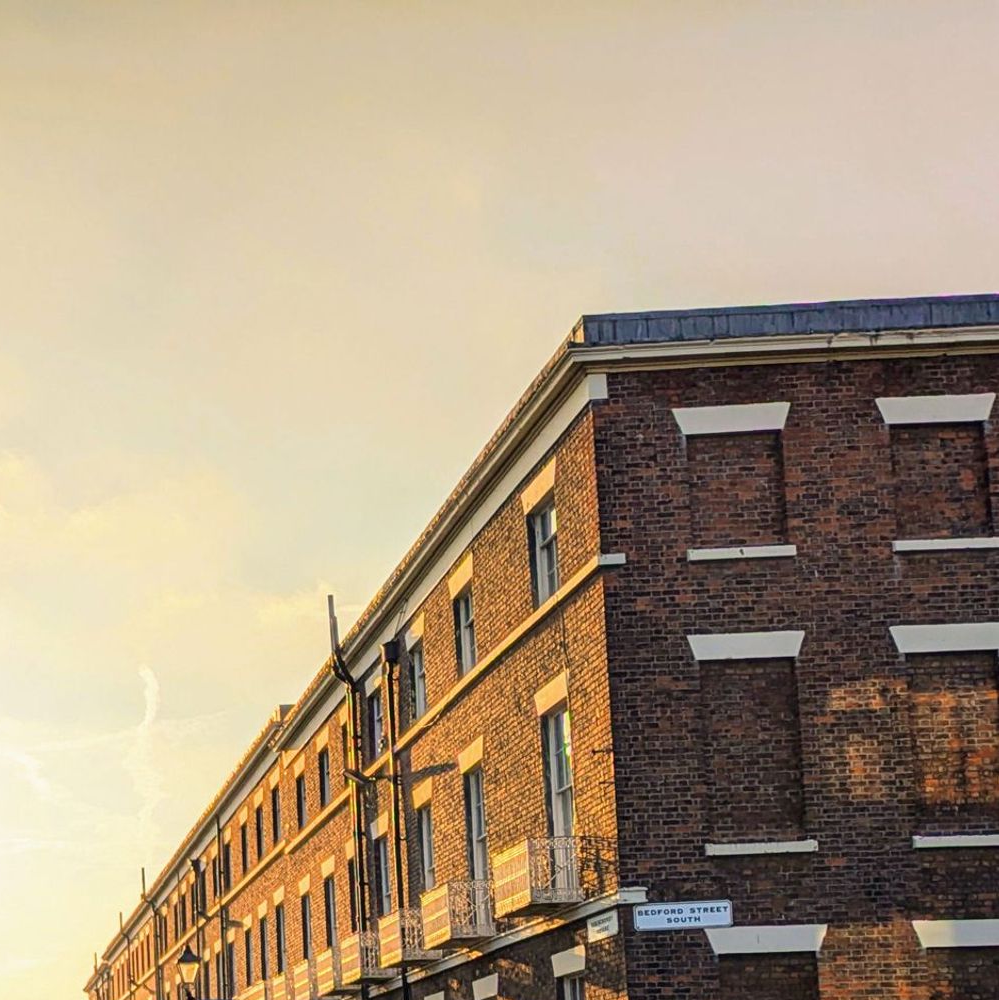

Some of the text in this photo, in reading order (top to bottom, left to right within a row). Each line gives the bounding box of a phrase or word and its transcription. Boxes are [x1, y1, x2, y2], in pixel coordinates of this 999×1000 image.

[637, 905, 729, 917] BEDFORD STREET
[666, 916, 701, 924] SOUTH
